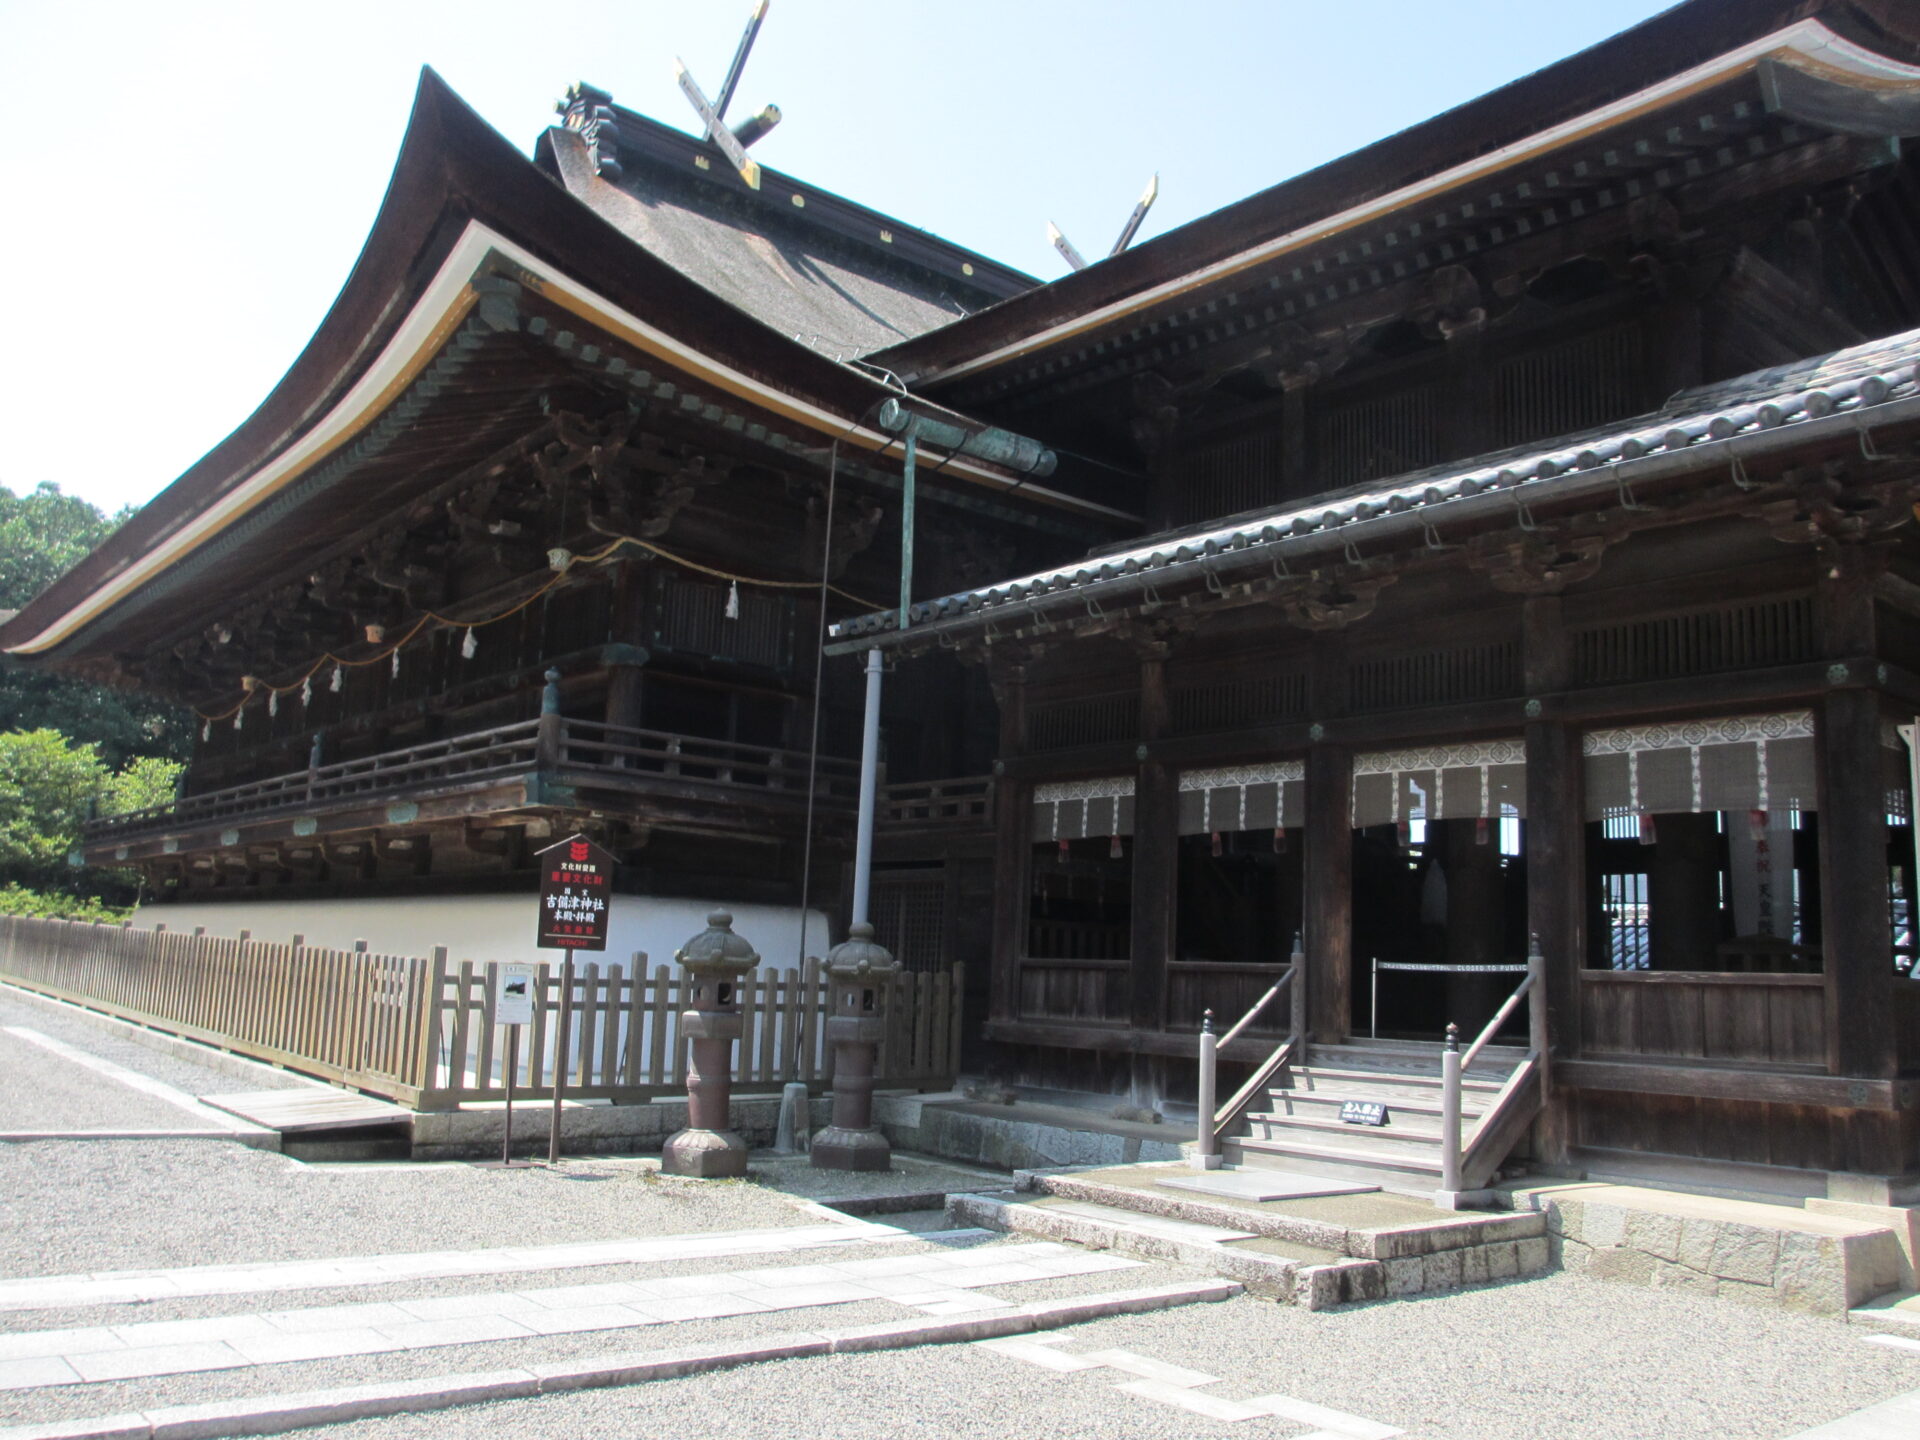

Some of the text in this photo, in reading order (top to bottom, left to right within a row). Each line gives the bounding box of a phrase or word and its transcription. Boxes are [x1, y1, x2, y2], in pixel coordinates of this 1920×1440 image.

[546, 894, 604, 910] 吉備津神社
[1343, 1102, 1380, 1116] 立入禁止
